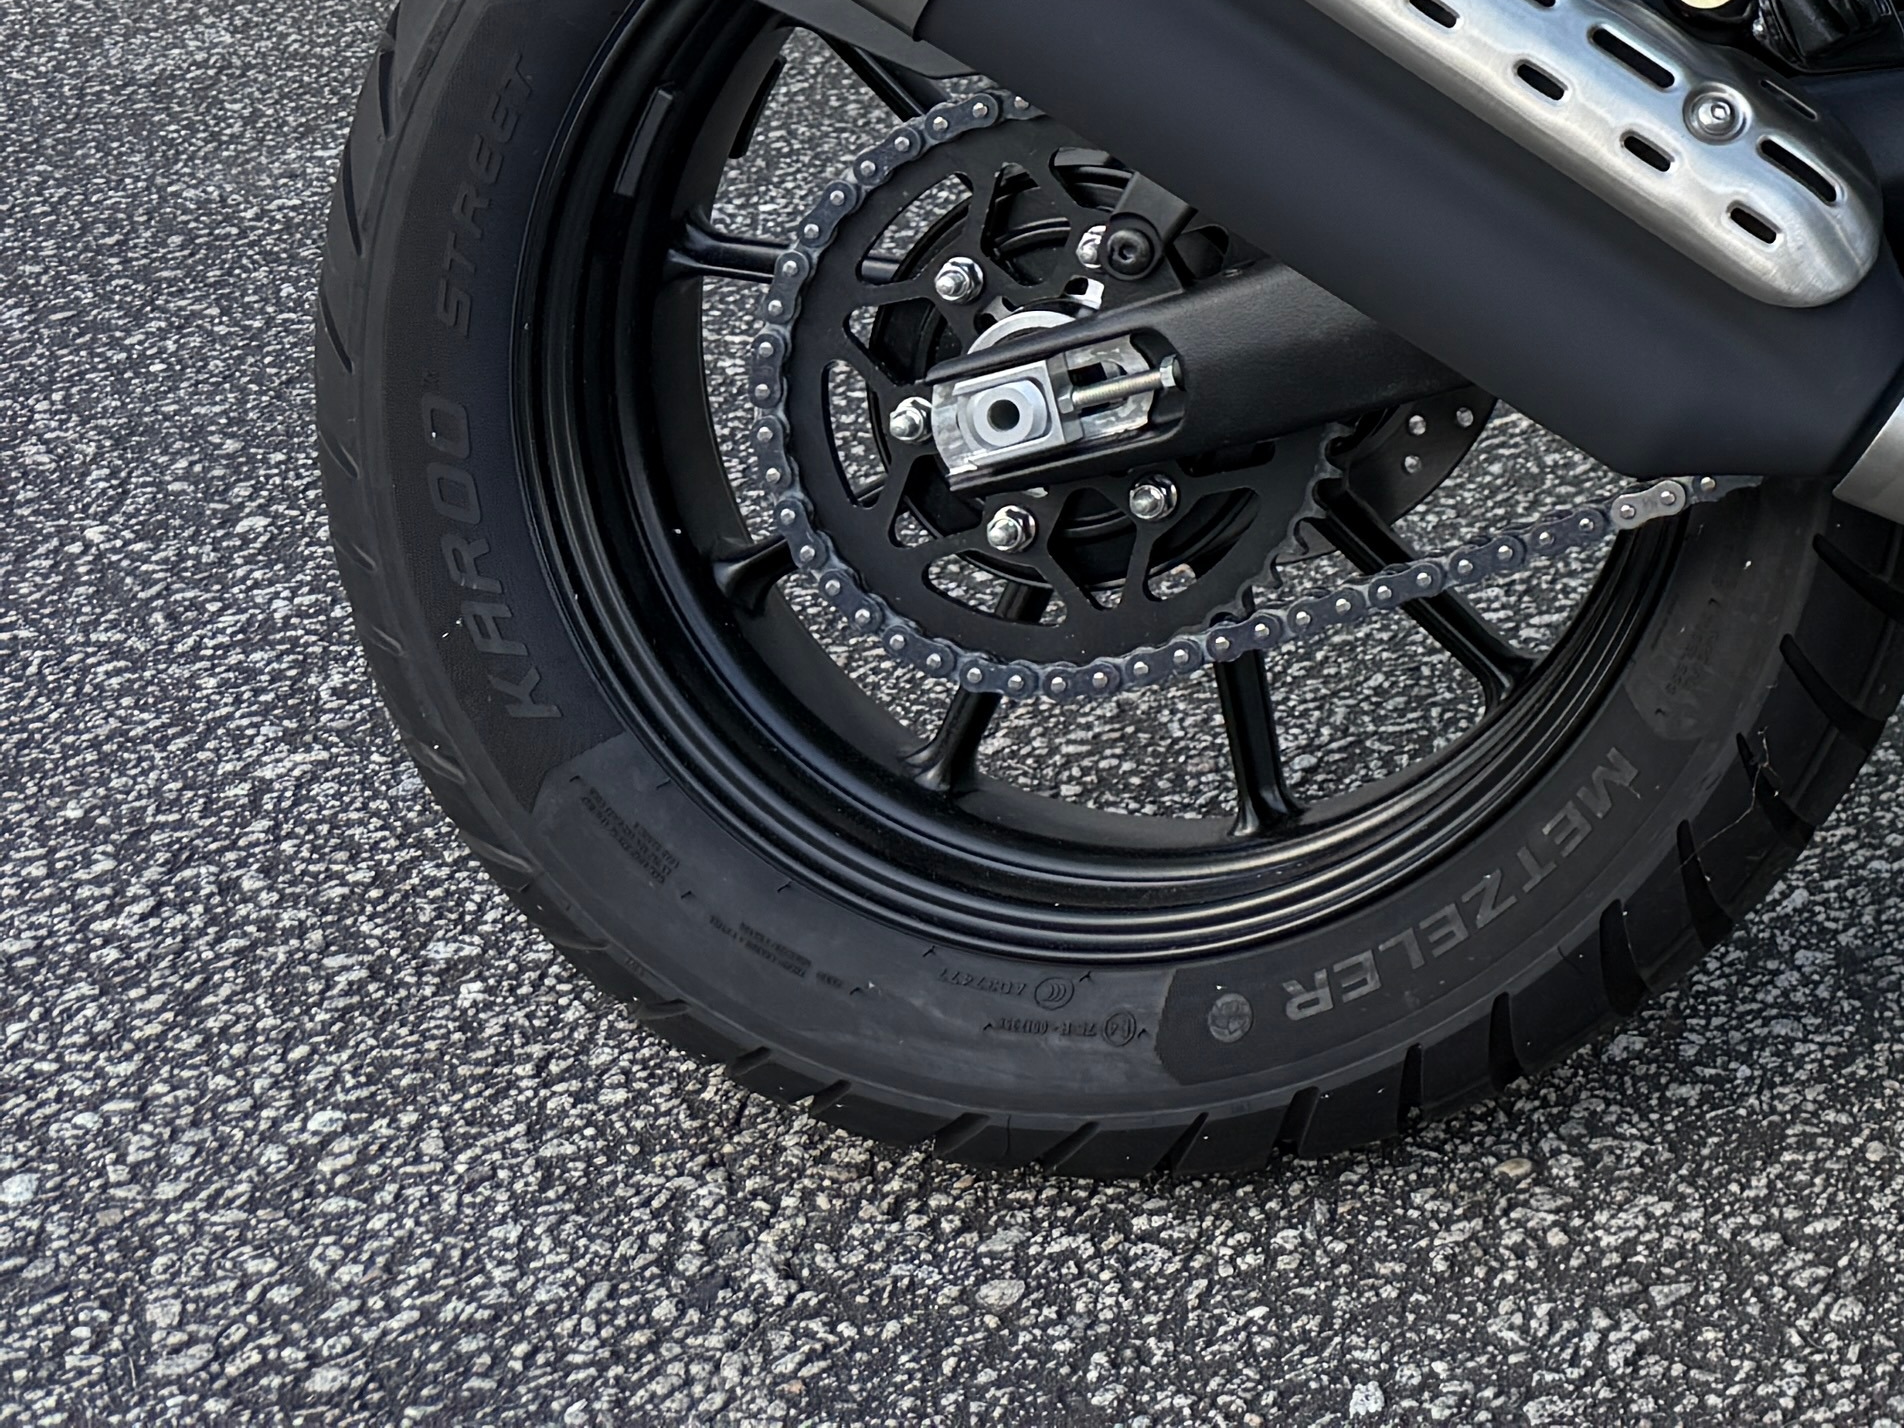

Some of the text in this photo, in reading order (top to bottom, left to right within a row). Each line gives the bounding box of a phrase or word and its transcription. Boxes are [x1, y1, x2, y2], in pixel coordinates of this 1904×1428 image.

[422, 51, 563, 719] KAROO STREET
[1281, 746, 1639, 1022] METZELER
